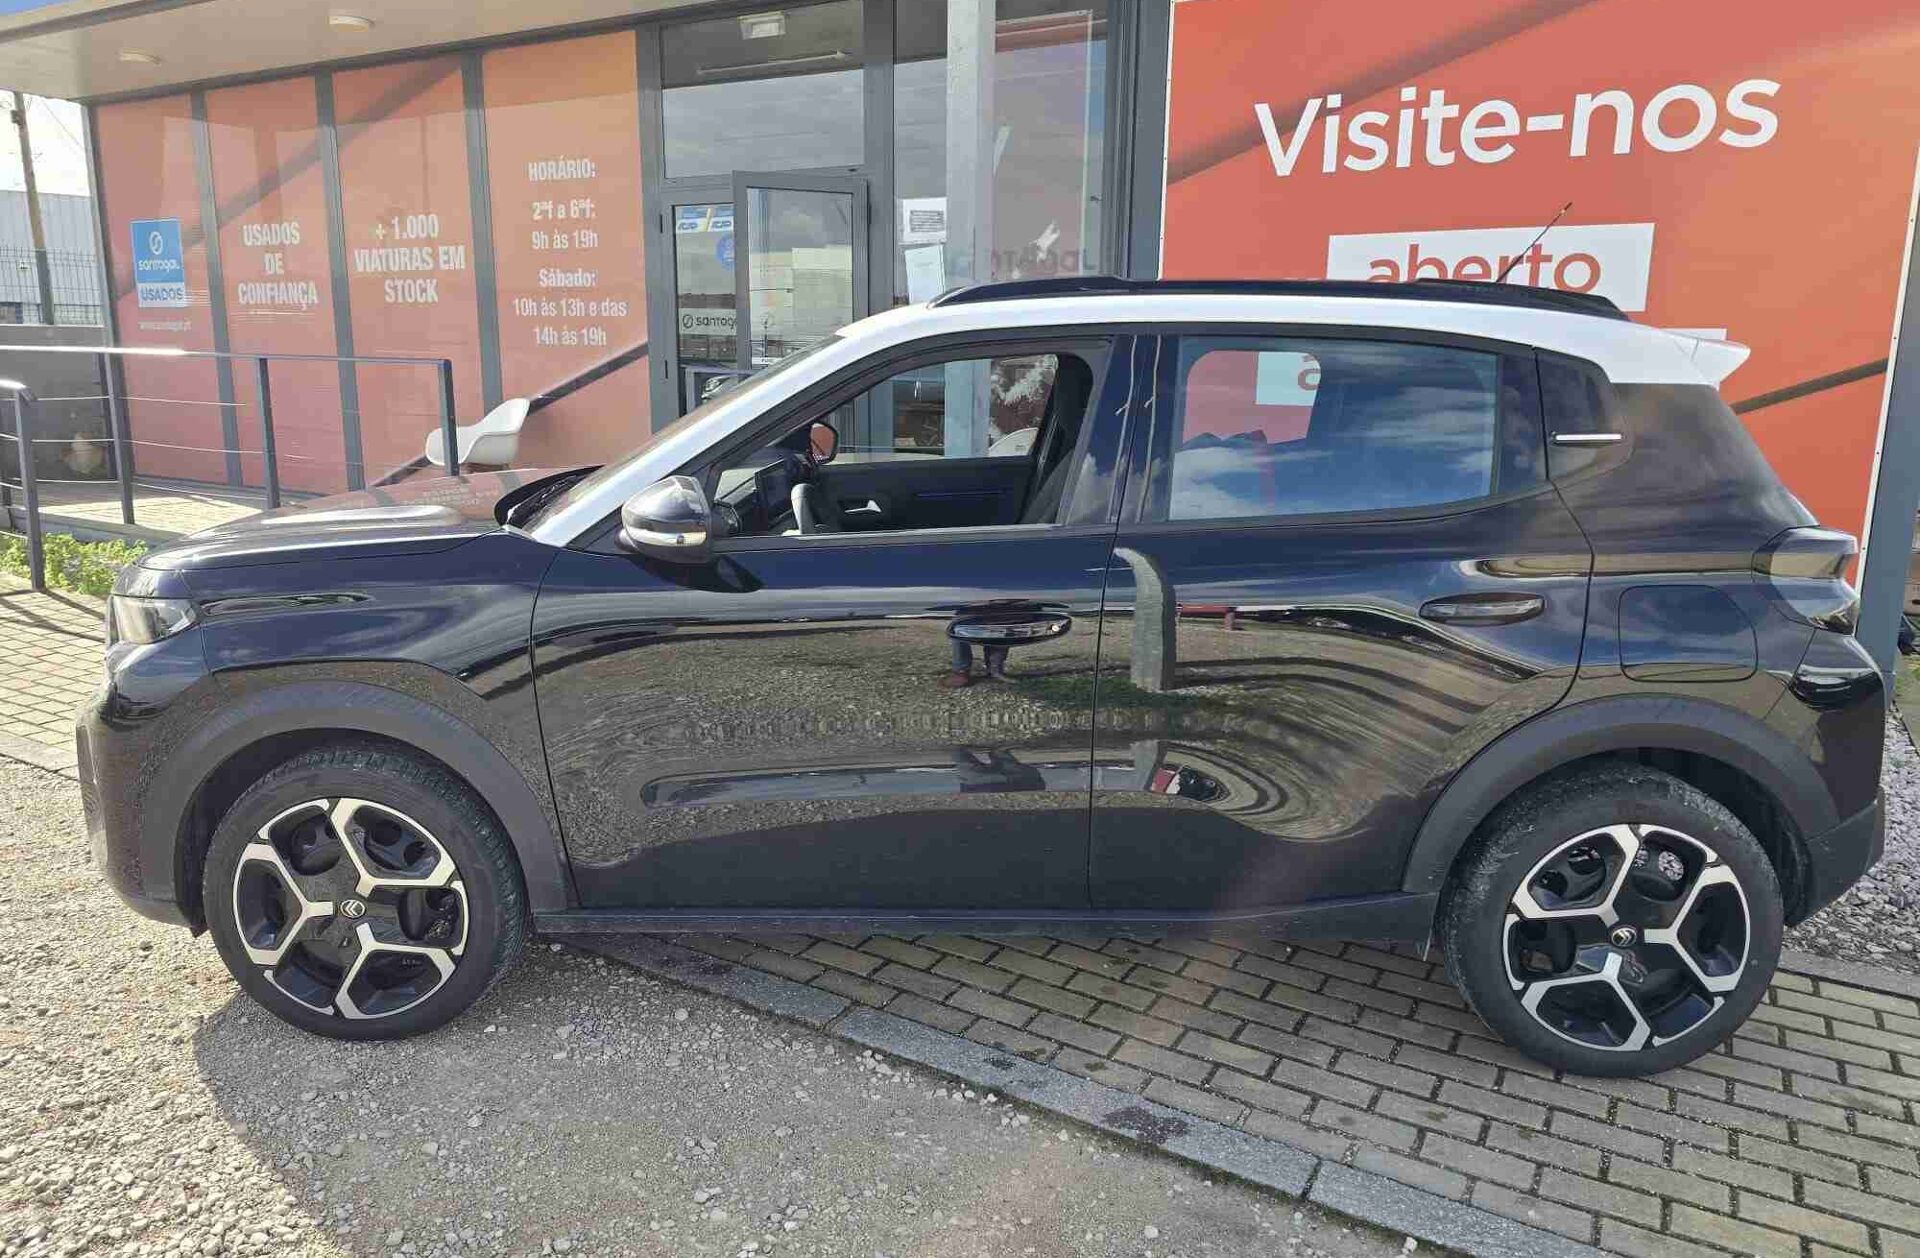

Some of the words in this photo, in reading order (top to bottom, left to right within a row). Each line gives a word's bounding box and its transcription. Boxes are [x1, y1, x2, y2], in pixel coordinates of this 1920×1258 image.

[1254, 79, 1781, 176] Visite-nos
[528, 155, 596, 181] HORÁRIO:
[558, 204, 566, 219] a
[243, 222, 300, 247] USADOS
[392, 214, 439, 239] 1.000
[532, 231, 549, 249] 9h
[553, 228, 568, 249] às
[573, 229, 598, 248] 19h
[264, 252, 284, 275] DE
[354, 248, 433, 272] VIATURAS
[439, 245, 465, 270] EM
[1367, 243, 1601, 294] aberto
[539, 268, 596, 287] Sábado:
[141, 288, 184, 301] USADOS
[238, 282, 318, 310] CONFIANÇA
[384, 278, 438, 303] STOCK
[513, 298, 537, 316] 10h
[541, 297, 557, 316] às
[561, 299, 585, 317] 13h
[589, 302, 597, 316] e
[601, 298, 627, 316] das
[533, 326, 558, 345] 14h
[561, 325, 577, 345] às
[579, 327, 607, 345] 19h
